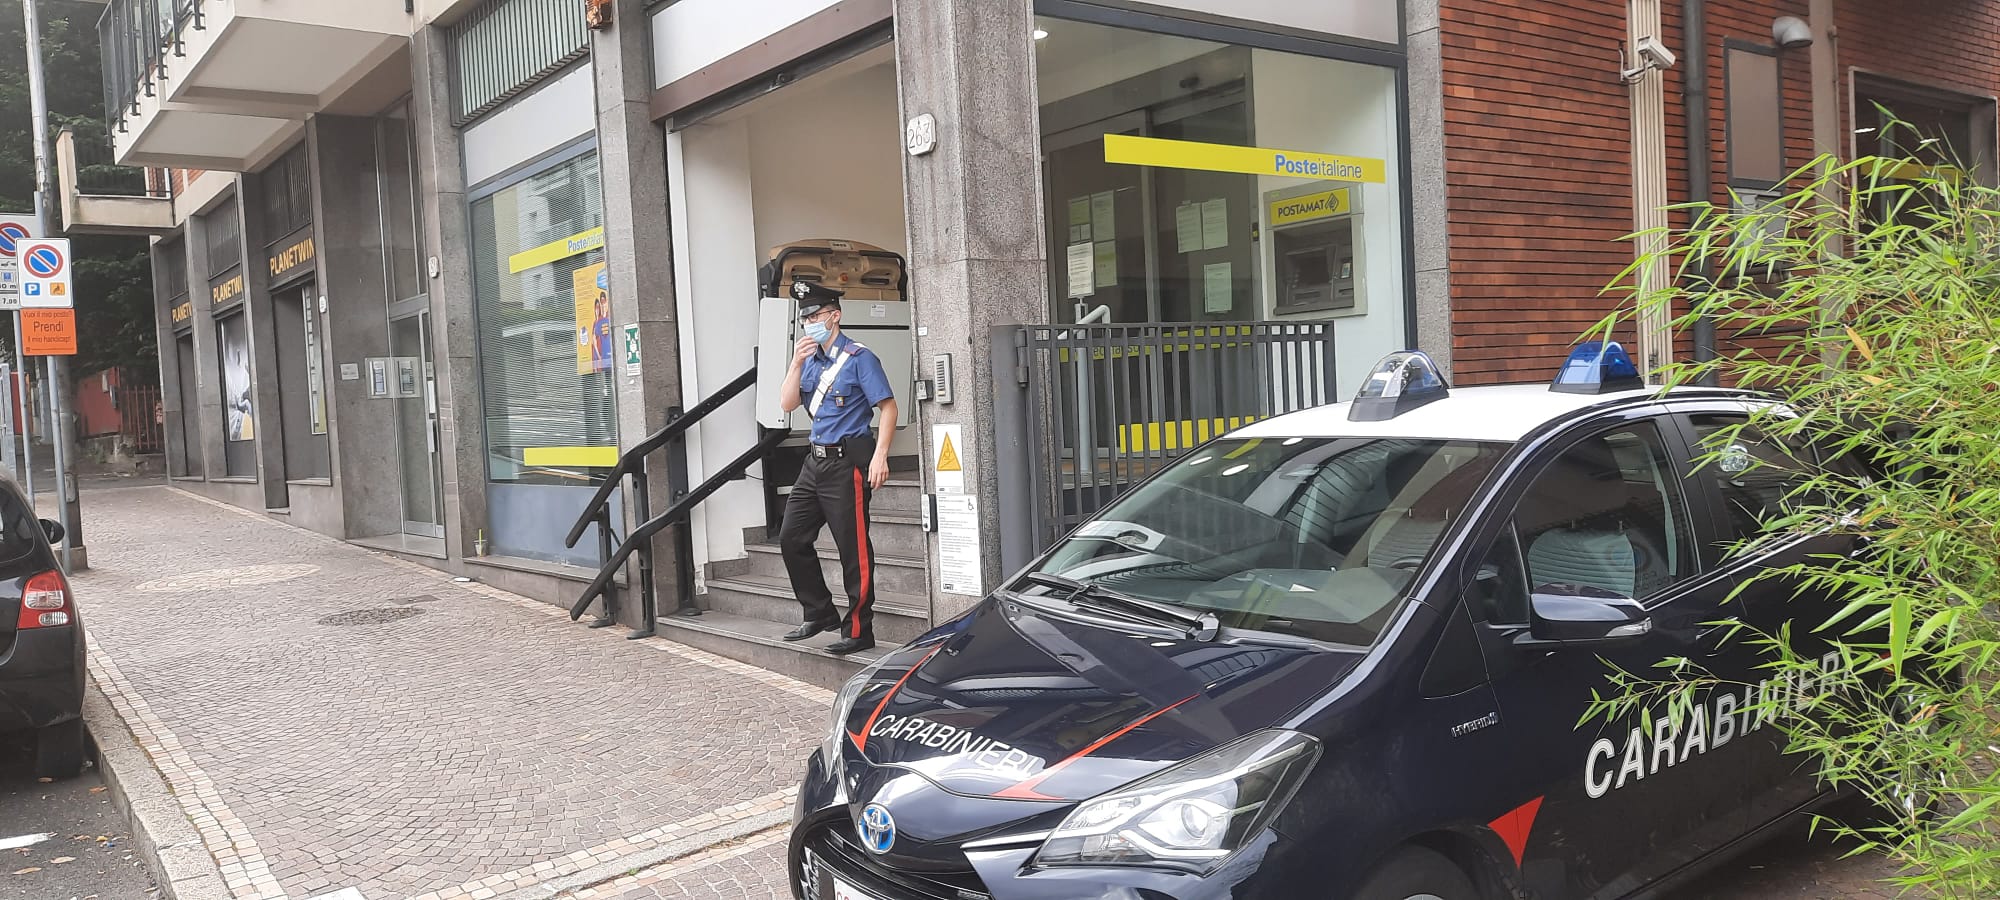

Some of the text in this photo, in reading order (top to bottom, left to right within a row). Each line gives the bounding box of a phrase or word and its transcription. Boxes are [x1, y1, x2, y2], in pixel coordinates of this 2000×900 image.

[907, 122, 931, 149] 263
[1275, 154, 1362, 178] Posteitaliane
[1278, 199, 1325, 217] POSTAMAT
[33, 320, 64, 332] Prendi
[870, 714, 1039, 777] CARABINIERI
